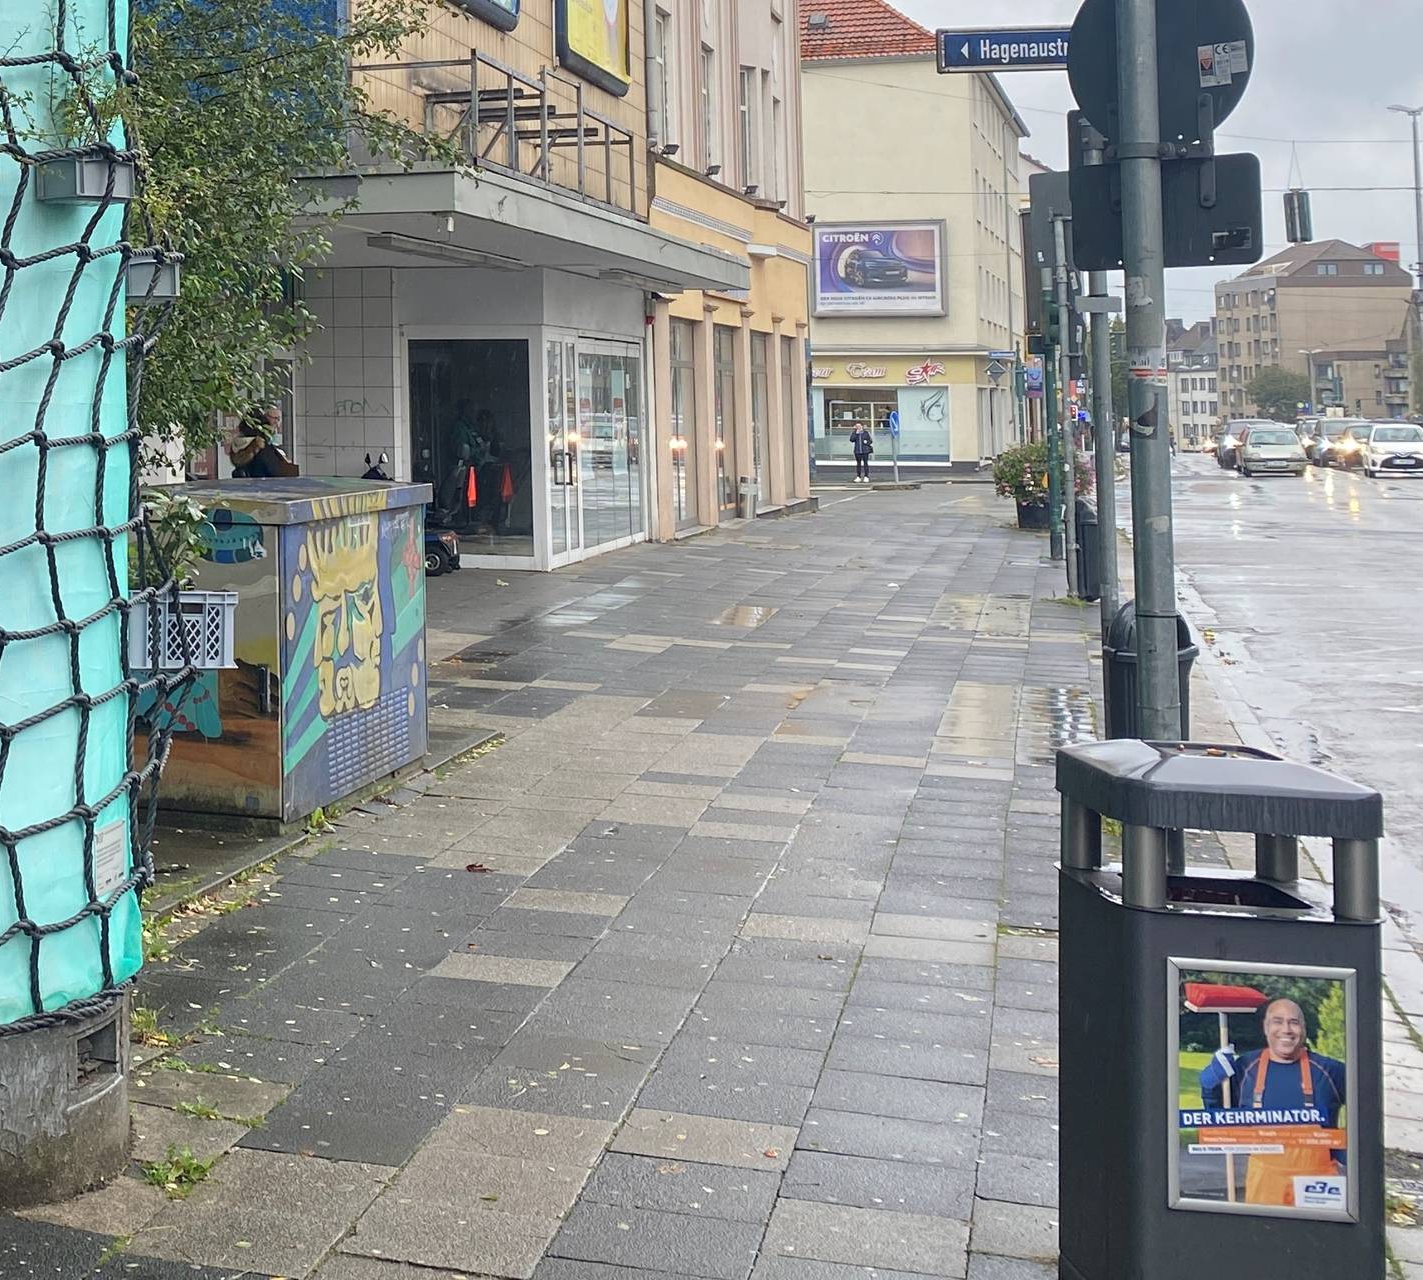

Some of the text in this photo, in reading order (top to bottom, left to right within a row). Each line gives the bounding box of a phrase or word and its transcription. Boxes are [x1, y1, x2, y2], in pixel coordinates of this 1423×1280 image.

[822, 232, 869, 243] CITROËN
[1183, 1109, 1326, 1126] DER KEHRMINATOR.
